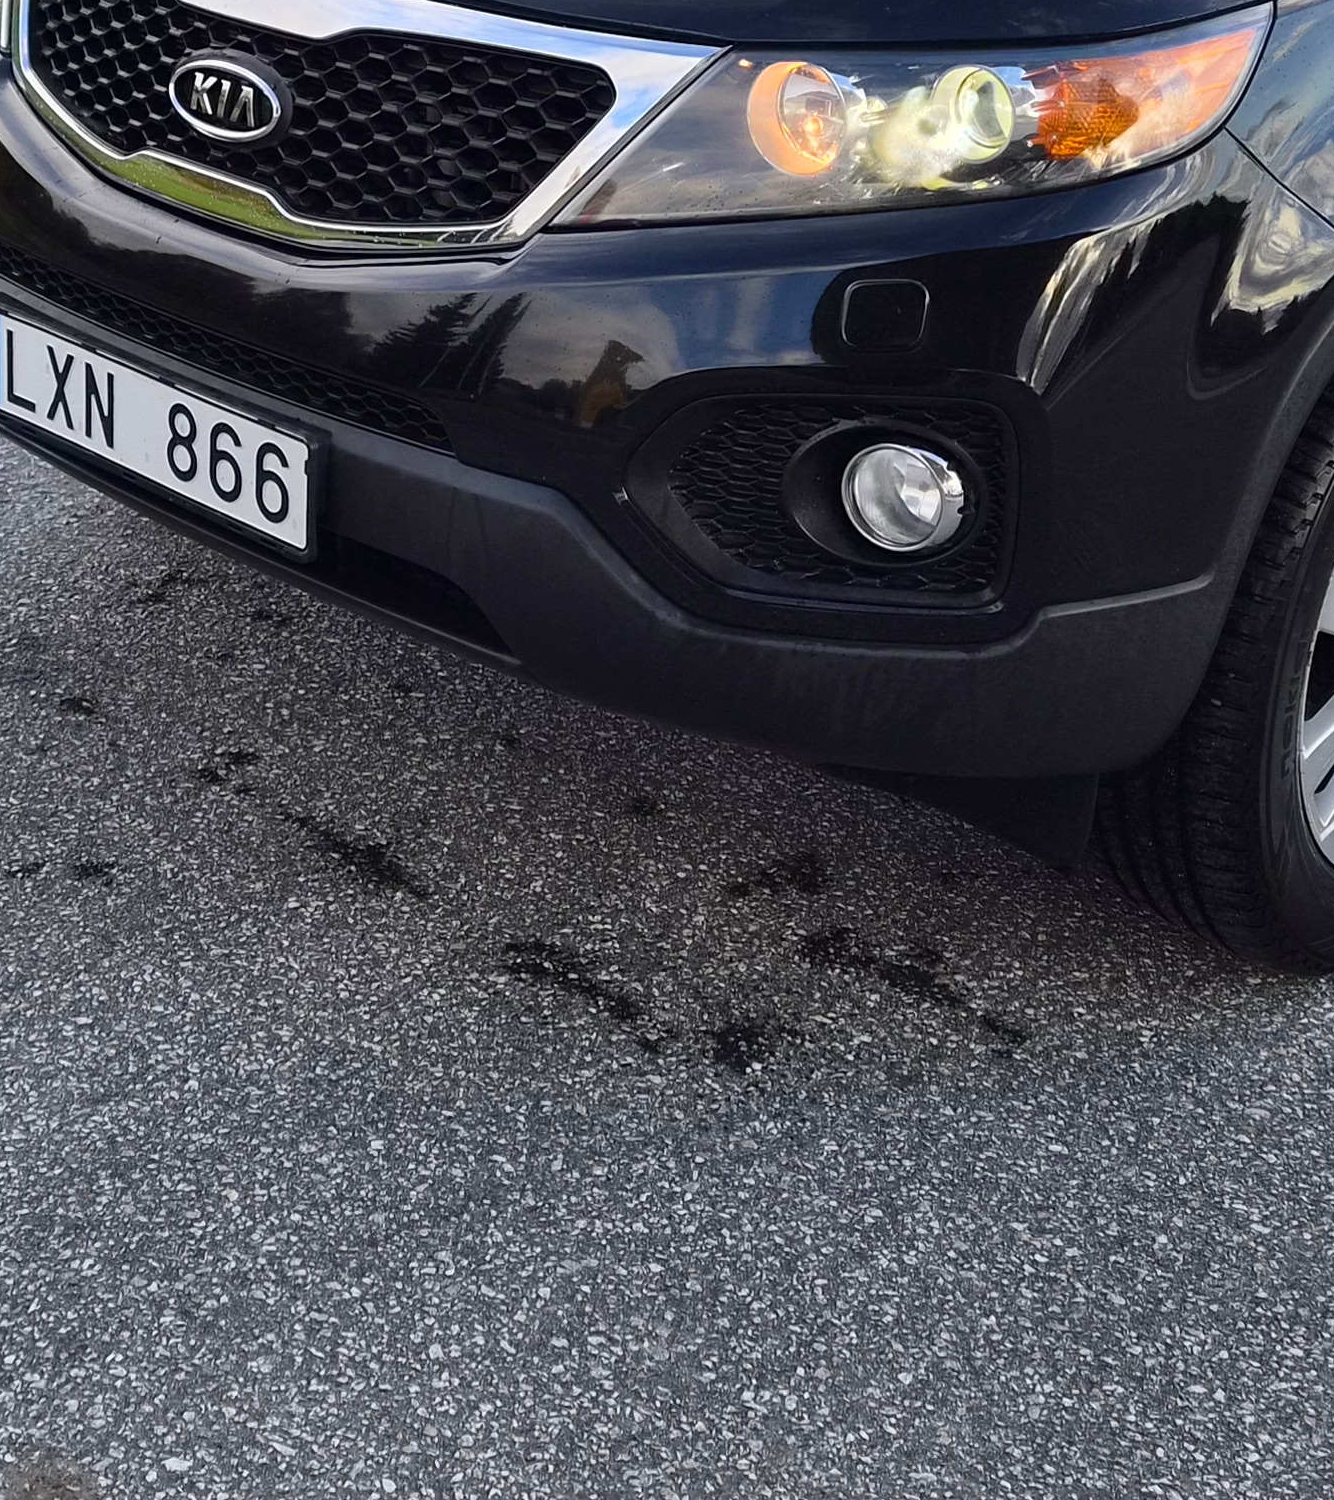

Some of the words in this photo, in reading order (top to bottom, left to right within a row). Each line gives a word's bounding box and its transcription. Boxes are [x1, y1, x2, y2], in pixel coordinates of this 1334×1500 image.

[190, 71, 255, 128] KIA
[6, 329, 115, 449] LXN
[167, 402, 289, 523] 866
